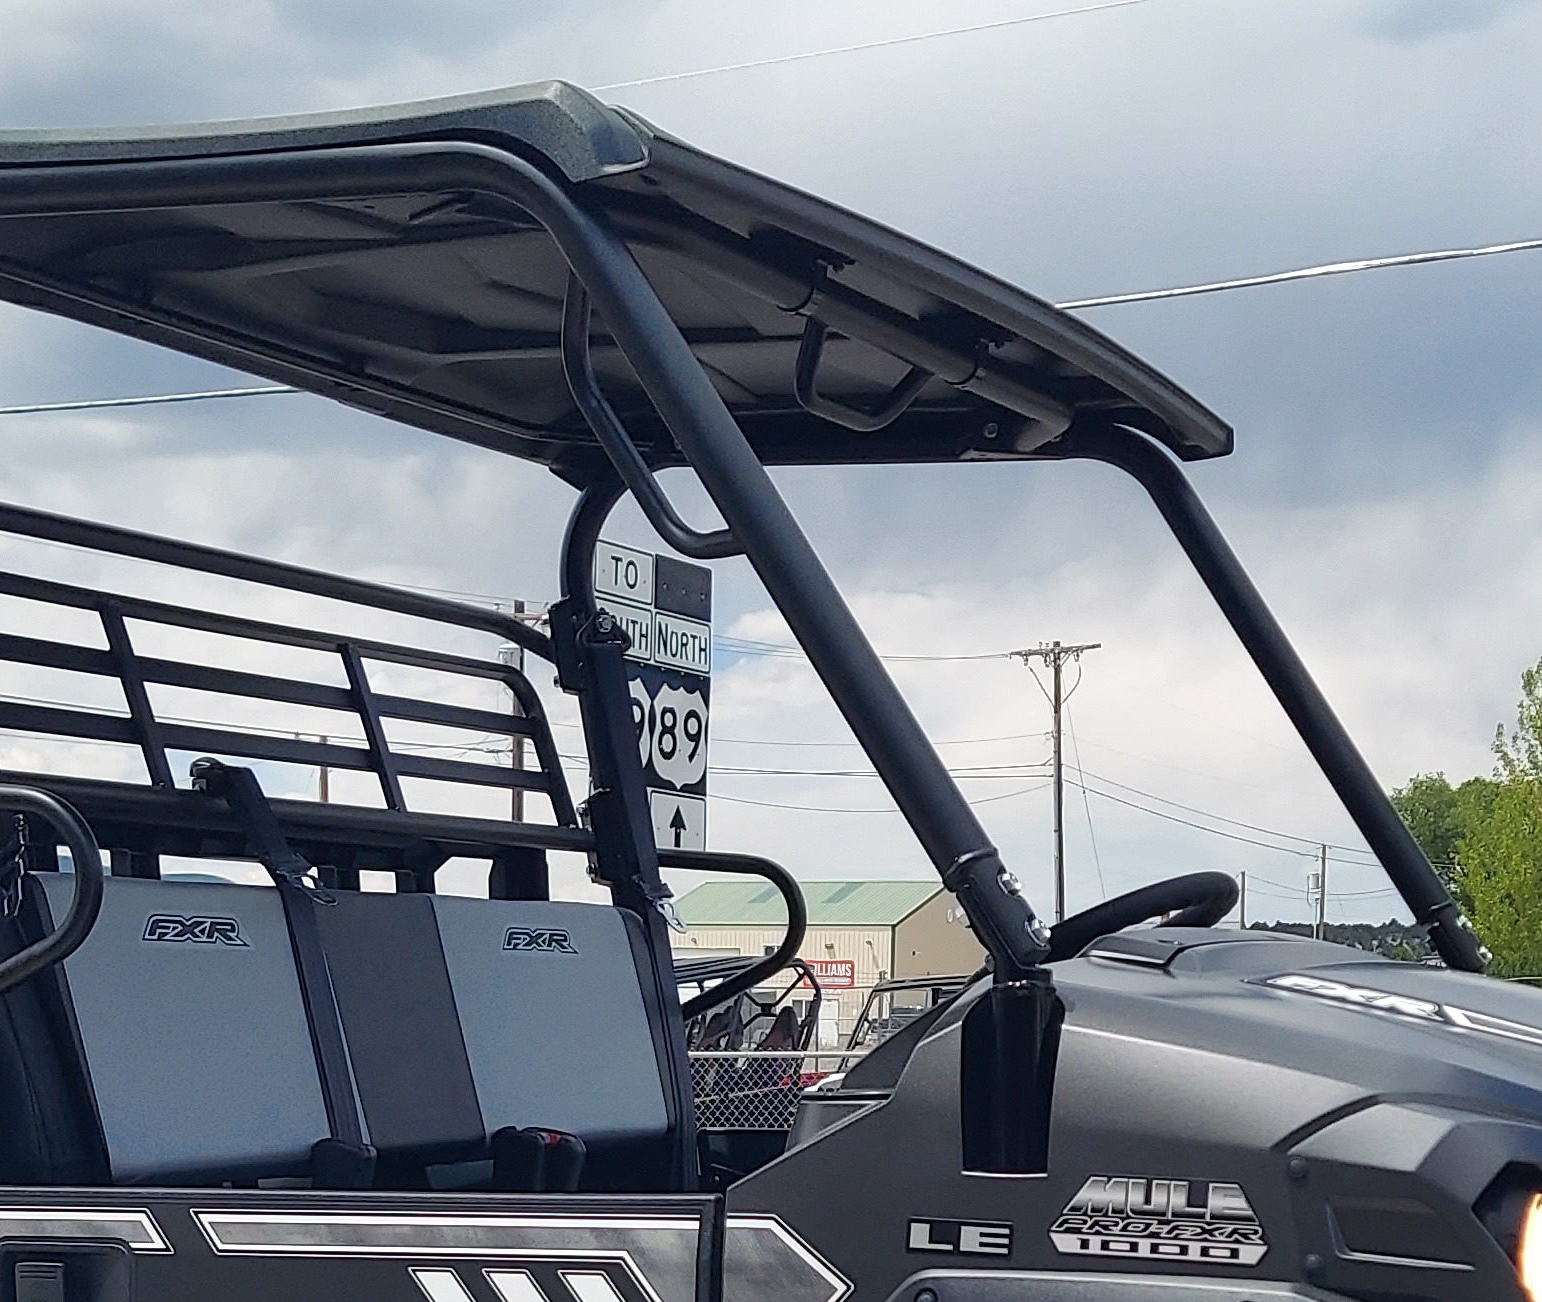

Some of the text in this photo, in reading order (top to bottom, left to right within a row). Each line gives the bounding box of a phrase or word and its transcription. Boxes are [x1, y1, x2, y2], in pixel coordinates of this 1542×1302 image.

[611, 555, 639, 589] TO
[658, 621, 708, 665] NORTH
[658, 706, 703, 764] 89
[142, 914, 250, 947] FXR
[502, 926, 579, 955] FXR
[812, 963, 852, 977] ILLIAMS
[1062, 1175, 1258, 1222] MULE
[909, 1222, 1010, 1254] LE
[1054, 1216, 1265, 1245] PRO-FXR
[1077, 1237, 1240, 1260] 1000
